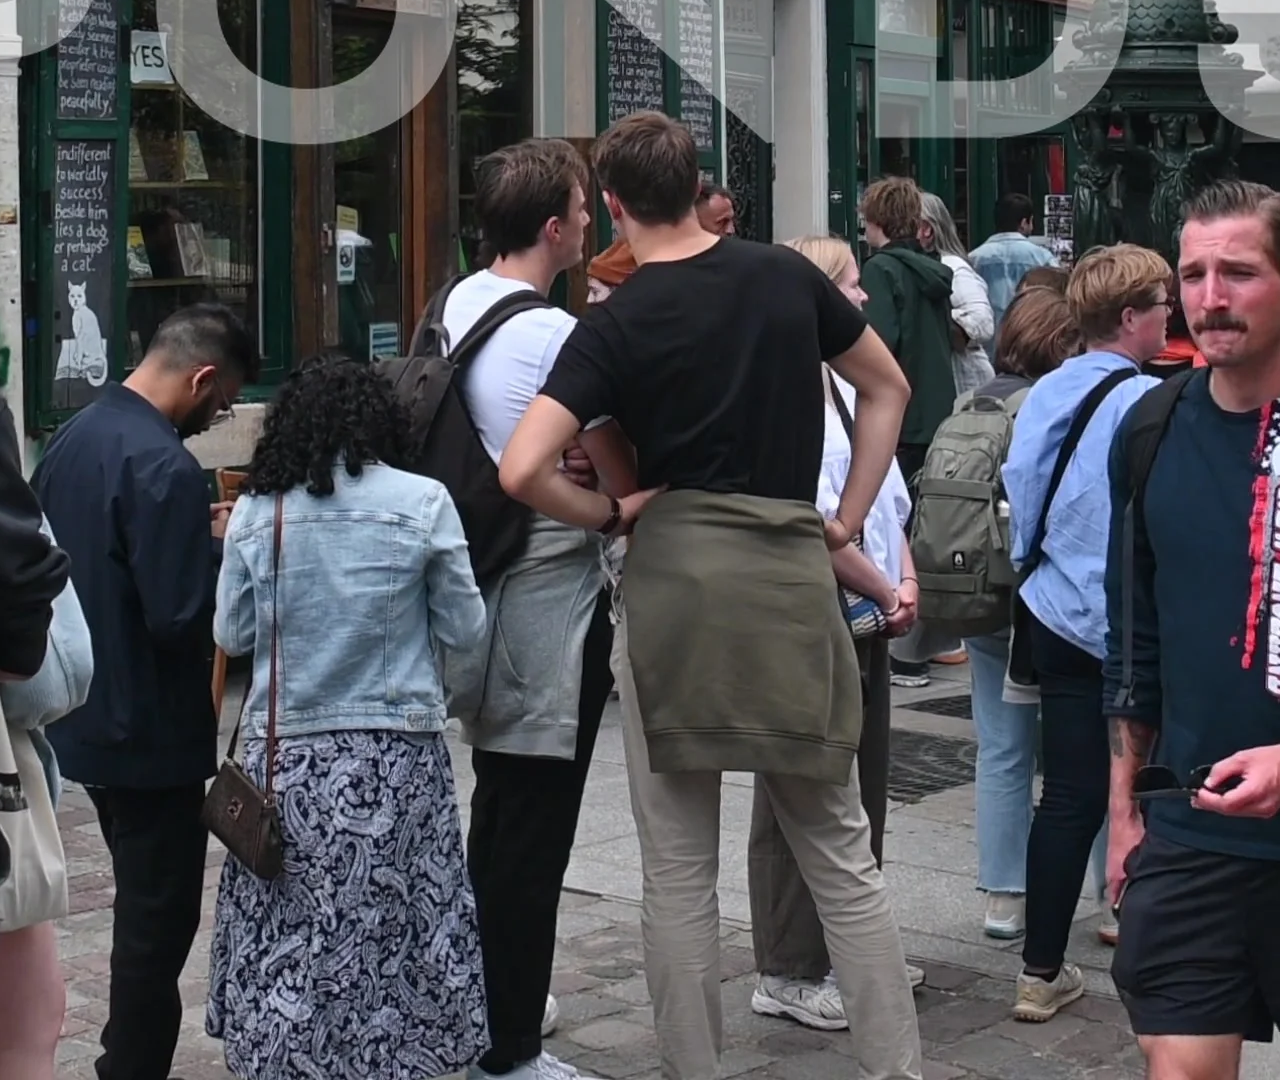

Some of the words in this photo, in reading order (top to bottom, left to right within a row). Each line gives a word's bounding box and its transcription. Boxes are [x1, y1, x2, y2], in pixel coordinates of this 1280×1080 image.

[130, 45, 164, 68] YES
[57, 142, 112, 165] indifferent
[56, 164, 66, 183] to
[67, 164, 108, 187] worldly
[55, 201, 87, 219] Beside
[88, 201, 108, 220] him
[56, 220, 73, 238] lies
[76, 223, 83, 238] a
[86, 220, 109, 247] dog
[66, 238, 103, 258] perhaps
[61, 258, 68, 272] a
[72, 255, 96, 272] cat.
